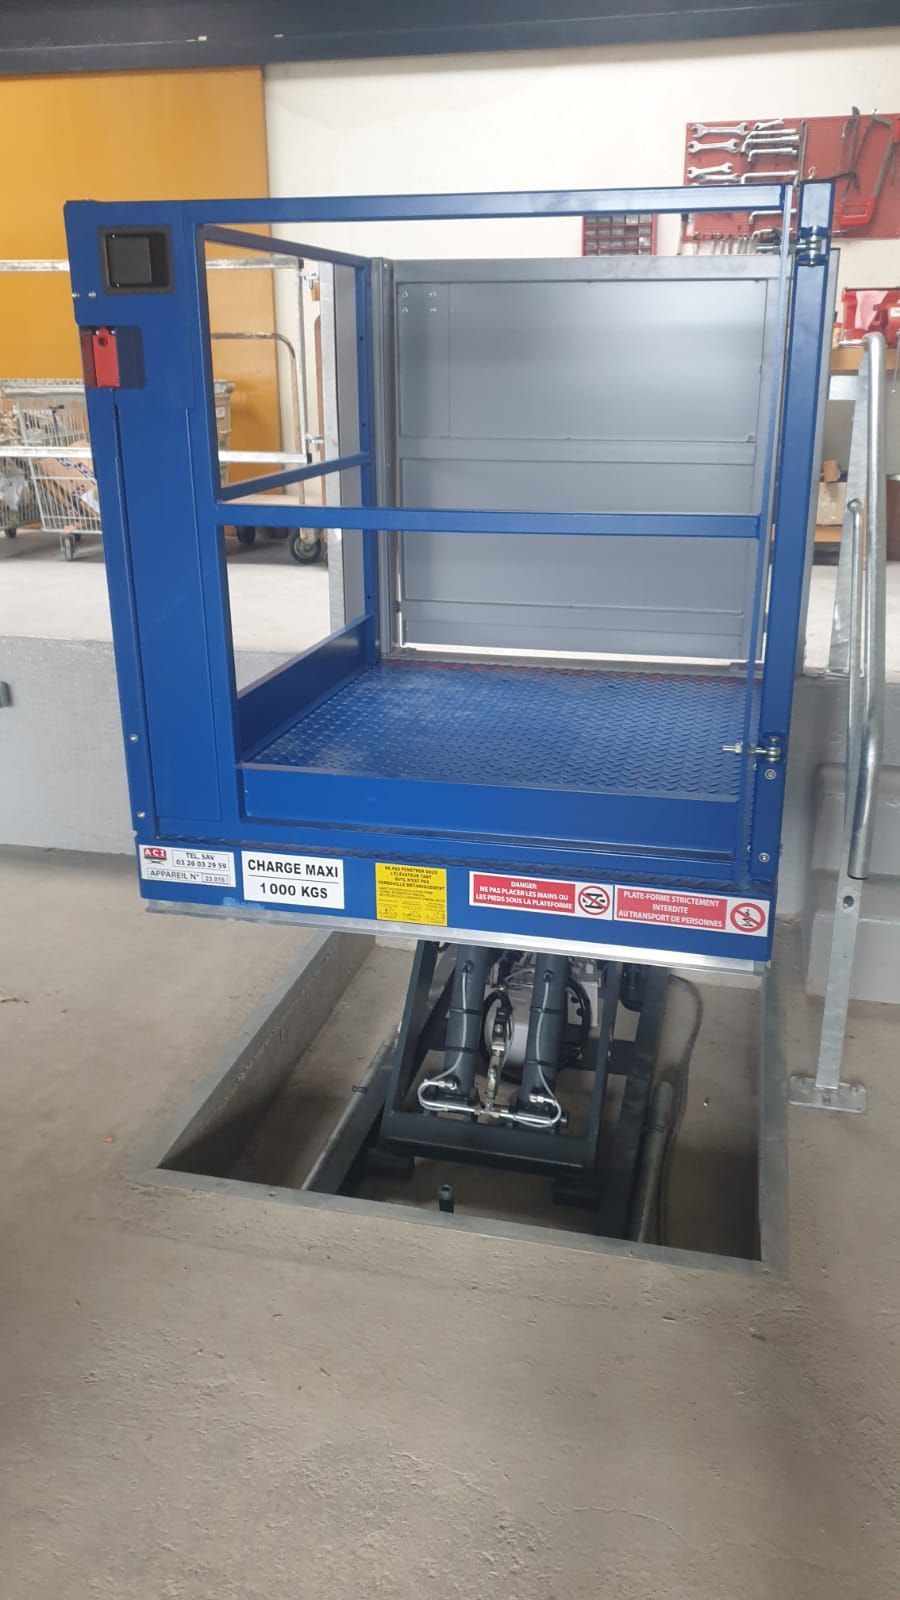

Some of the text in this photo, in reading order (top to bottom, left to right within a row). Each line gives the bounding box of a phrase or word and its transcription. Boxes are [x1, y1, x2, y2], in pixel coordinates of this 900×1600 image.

[150, 870, 189, 880] APPAREIL
[248, 859, 339, 878] CHARGE MAXI
[301, 886, 328, 899] KGS
[479, 885, 489, 893] NE
[489, 886, 503, 894] PAS
[502, 888, 526, 897] PLACER
[537, 892, 558, 900] MAINS
[510, 881, 537, 890] DANGER
[475, 893, 488, 901] LES
[505, 896, 522, 904] SOUS
[522, 898, 533, 906] LA
[531, 900, 573, 910] PLATEFORME
[623, 890, 720, 908] PLATE-FORME STRICTEMENT
[652, 903, 689, 914] INTERDITE
[618, 909, 723, 928] AU TRANSPORT DE PERSONNES
